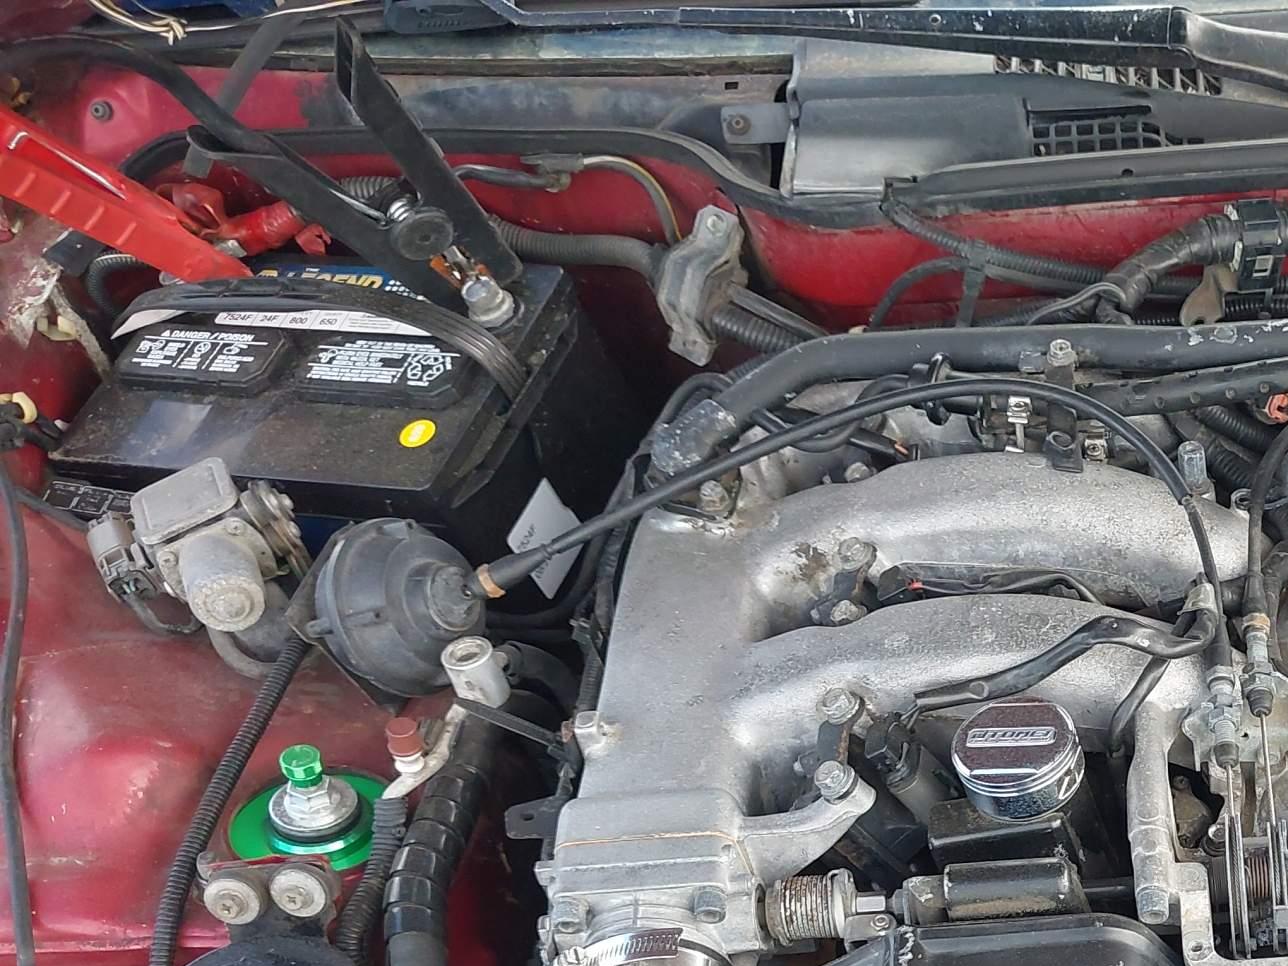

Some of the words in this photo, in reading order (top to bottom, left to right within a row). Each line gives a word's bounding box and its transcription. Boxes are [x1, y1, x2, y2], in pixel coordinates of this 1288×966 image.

[223, 312, 251, 322] 7524F
[171, 330, 210, 340] DANGER
[218, 332, 255, 342] POISON
